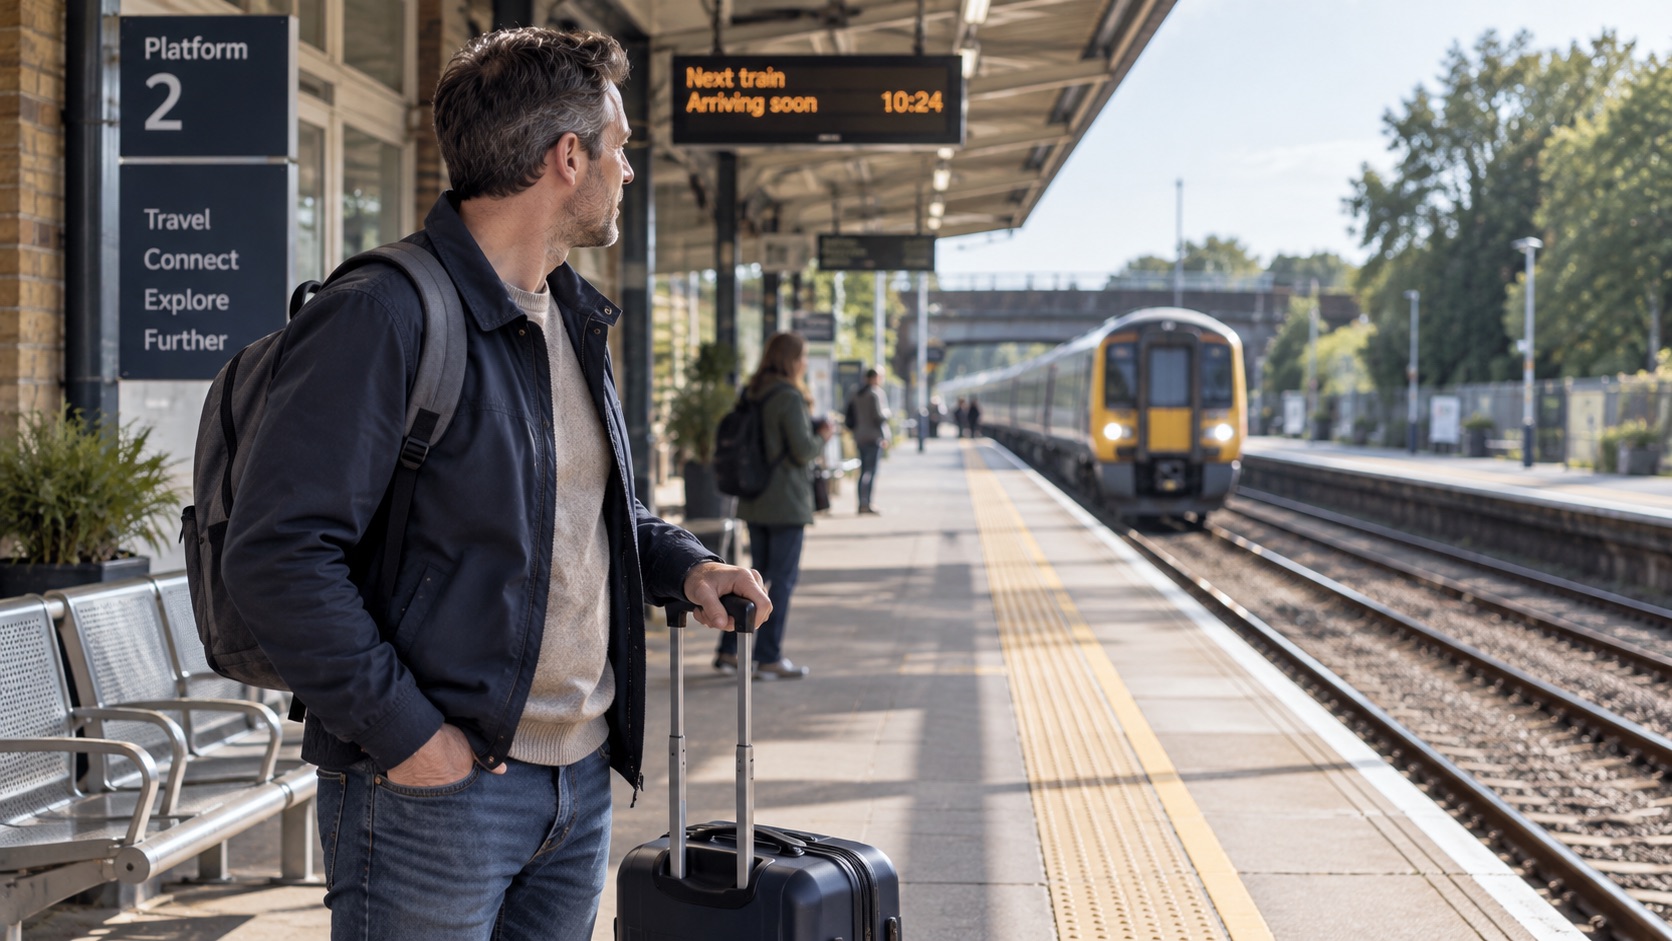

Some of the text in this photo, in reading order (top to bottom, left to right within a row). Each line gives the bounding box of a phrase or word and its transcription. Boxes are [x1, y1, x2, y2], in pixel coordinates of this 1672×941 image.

[145, 36, 247, 60] Platform
[686, 67, 786, 88] Next train
[145, 73, 182, 130] 2
[686, 90, 943, 117] Arriving soon 10:24
[144, 208, 210, 230] Travel
[144, 248, 239, 270] Connect
[144, 289, 229, 315] Explore
[144, 329, 228, 351] Further
